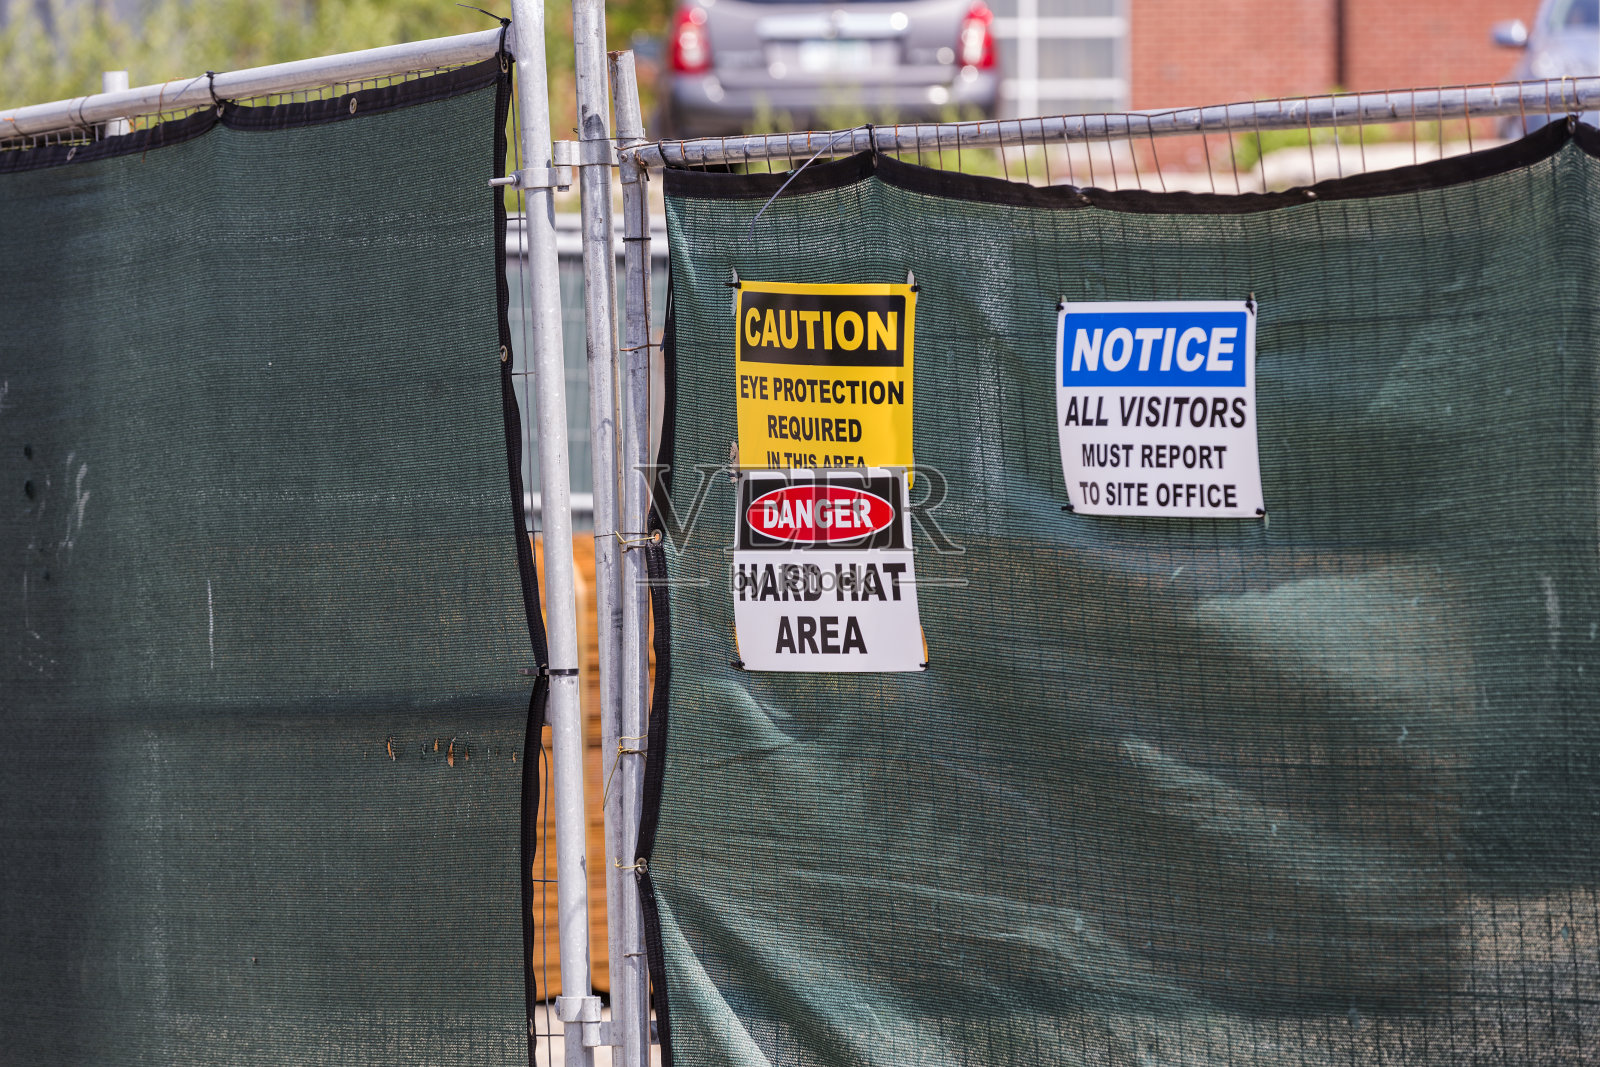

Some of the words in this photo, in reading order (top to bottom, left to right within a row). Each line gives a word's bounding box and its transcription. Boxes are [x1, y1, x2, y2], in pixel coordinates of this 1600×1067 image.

[744, 307, 898, 351] CAUTION
[1071, 327, 1238, 372] NOTICE
[740, 374, 769, 400] EYE
[773, 377, 904, 405] PROTECTION
[1065, 396, 1109, 427] ALL
[1119, 396, 1247, 428] VISITORS
[767, 414, 862, 443] REQUIRED
[767, 451, 780, 469] IN
[784, 452, 817, 469] THIS
[824, 454, 866, 469] AREA
[1082, 443, 1134, 468] MUST
[1141, 444, 1228, 469] REPORT
[1079, 481, 1100, 506] TO
[1106, 482, 1148, 507] SITE
[1156, 483, 1238, 508] OFFICE
[763, 498, 873, 529] DANGER
[739, 563, 823, 602] HARD
[834, 562, 907, 602] HAT
[775, 615, 868, 655] AREA
